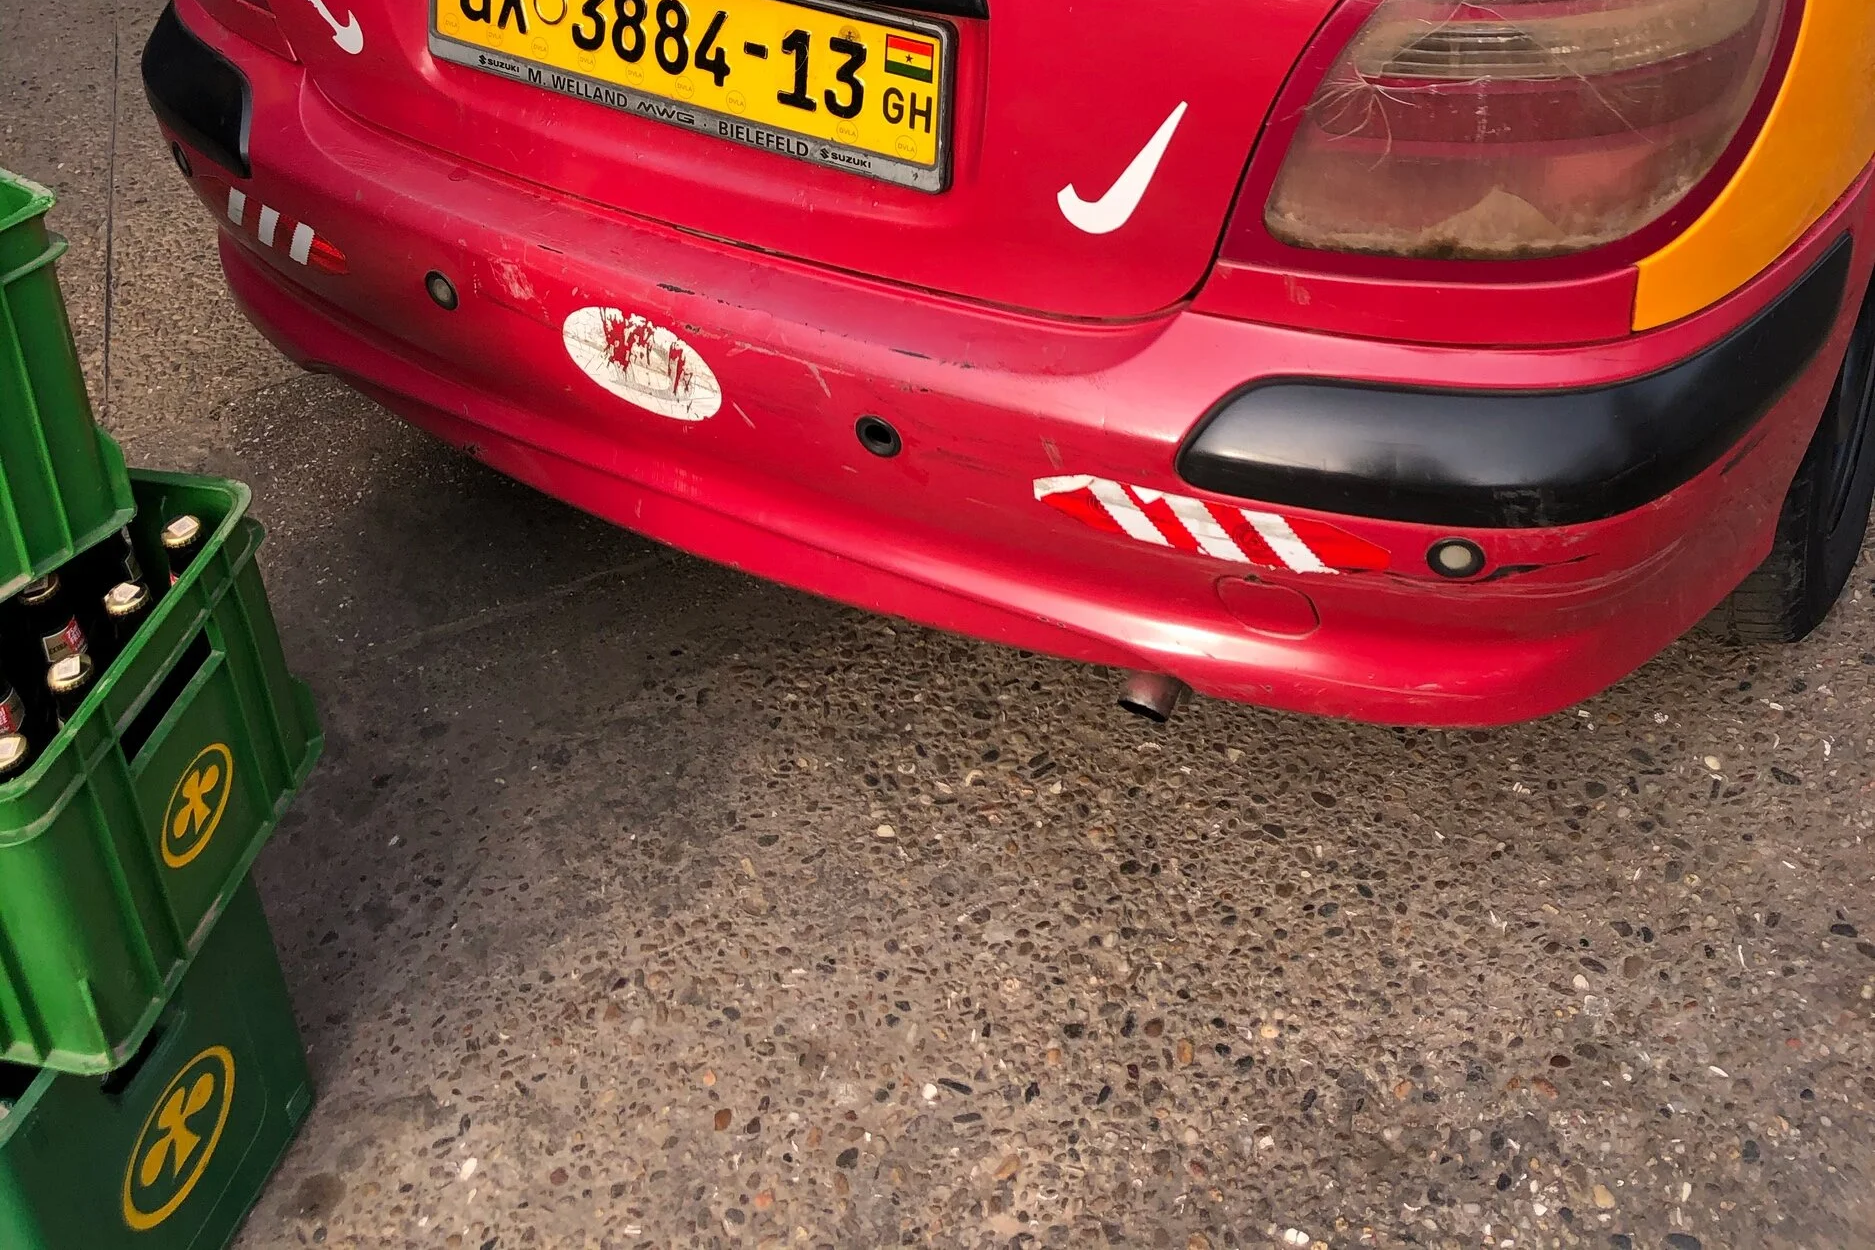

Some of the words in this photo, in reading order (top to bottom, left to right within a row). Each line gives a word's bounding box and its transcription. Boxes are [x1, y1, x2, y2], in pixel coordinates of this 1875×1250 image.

[487, 58, 520, 73] SUZUKI
[528, 67, 546, 86] M.
[552, 74, 628, 108] WELLAND
[718, 120, 809, 157] BIELEFELD
[882, 87, 933, 134] GH
[830, 152, 872, 169] SUZUKI
